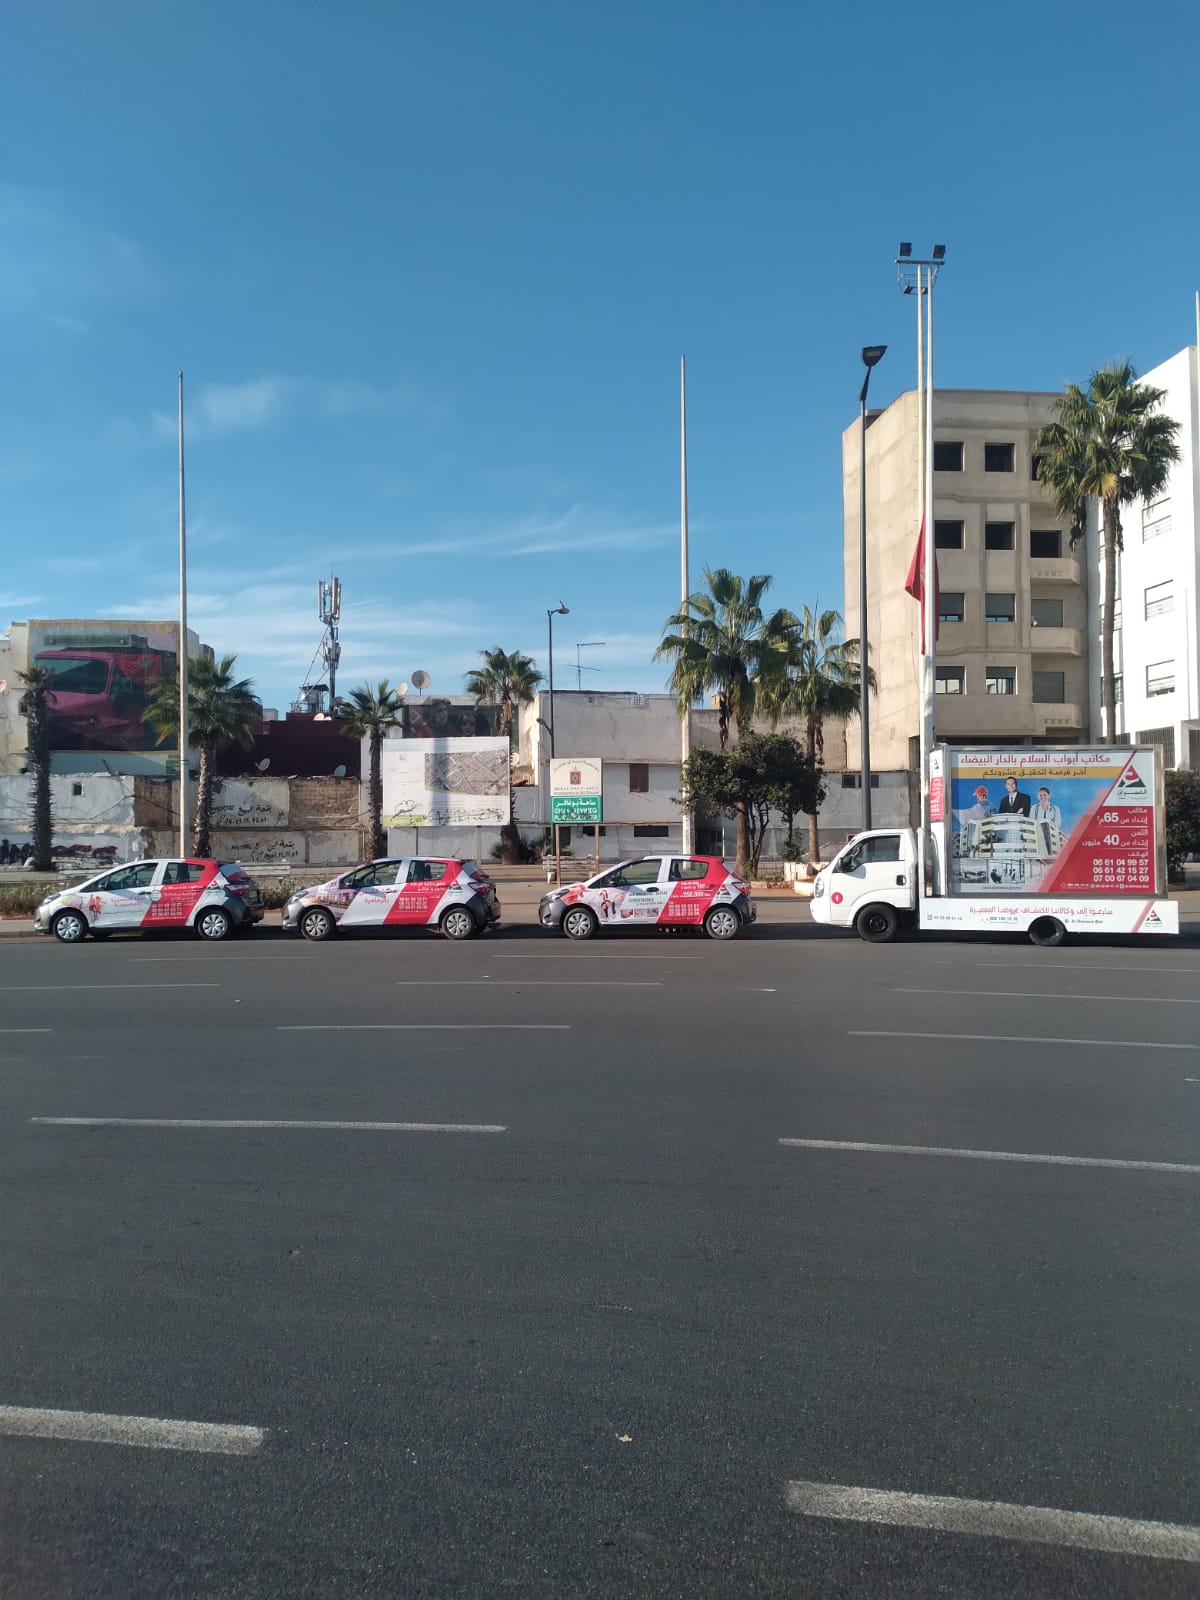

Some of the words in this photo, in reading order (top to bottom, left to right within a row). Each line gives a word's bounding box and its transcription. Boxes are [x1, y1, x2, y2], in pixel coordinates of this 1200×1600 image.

[960, 754, 992, 766] البيضاء
[995, 753, 1017, 767] بالدار
[1020, 753, 1051, 767] السلام
[1053, 752, 1079, 766] أبواب
[1081, 754, 1111, 766] مكاتب
[982, 768, 1017, 779] مشروعكم
[1018, 767, 1047, 778] لتحقيق
[1048, 767, 1071, 777] فرصة
[1082, 838, 1101, 847] مليون
[1103, 834, 1120, 846] 40
[1104, 858, 1114, 866] 61
[1116, 858, 1126, 866] 04
[1139, 858, 1149, 866] 57
[1104, 866, 1114, 874] 61
[1116, 866, 1126, 874] 42
[1127, 866, 1137, 874] 15
[1139, 866, 1149, 874] 27
[1093, 874, 1103, 882] 07
[1127, 874, 1137, 882] 04
[997, 905, 1020, 916] عروضنا
[1077, 907, 1088, 917] إلى
